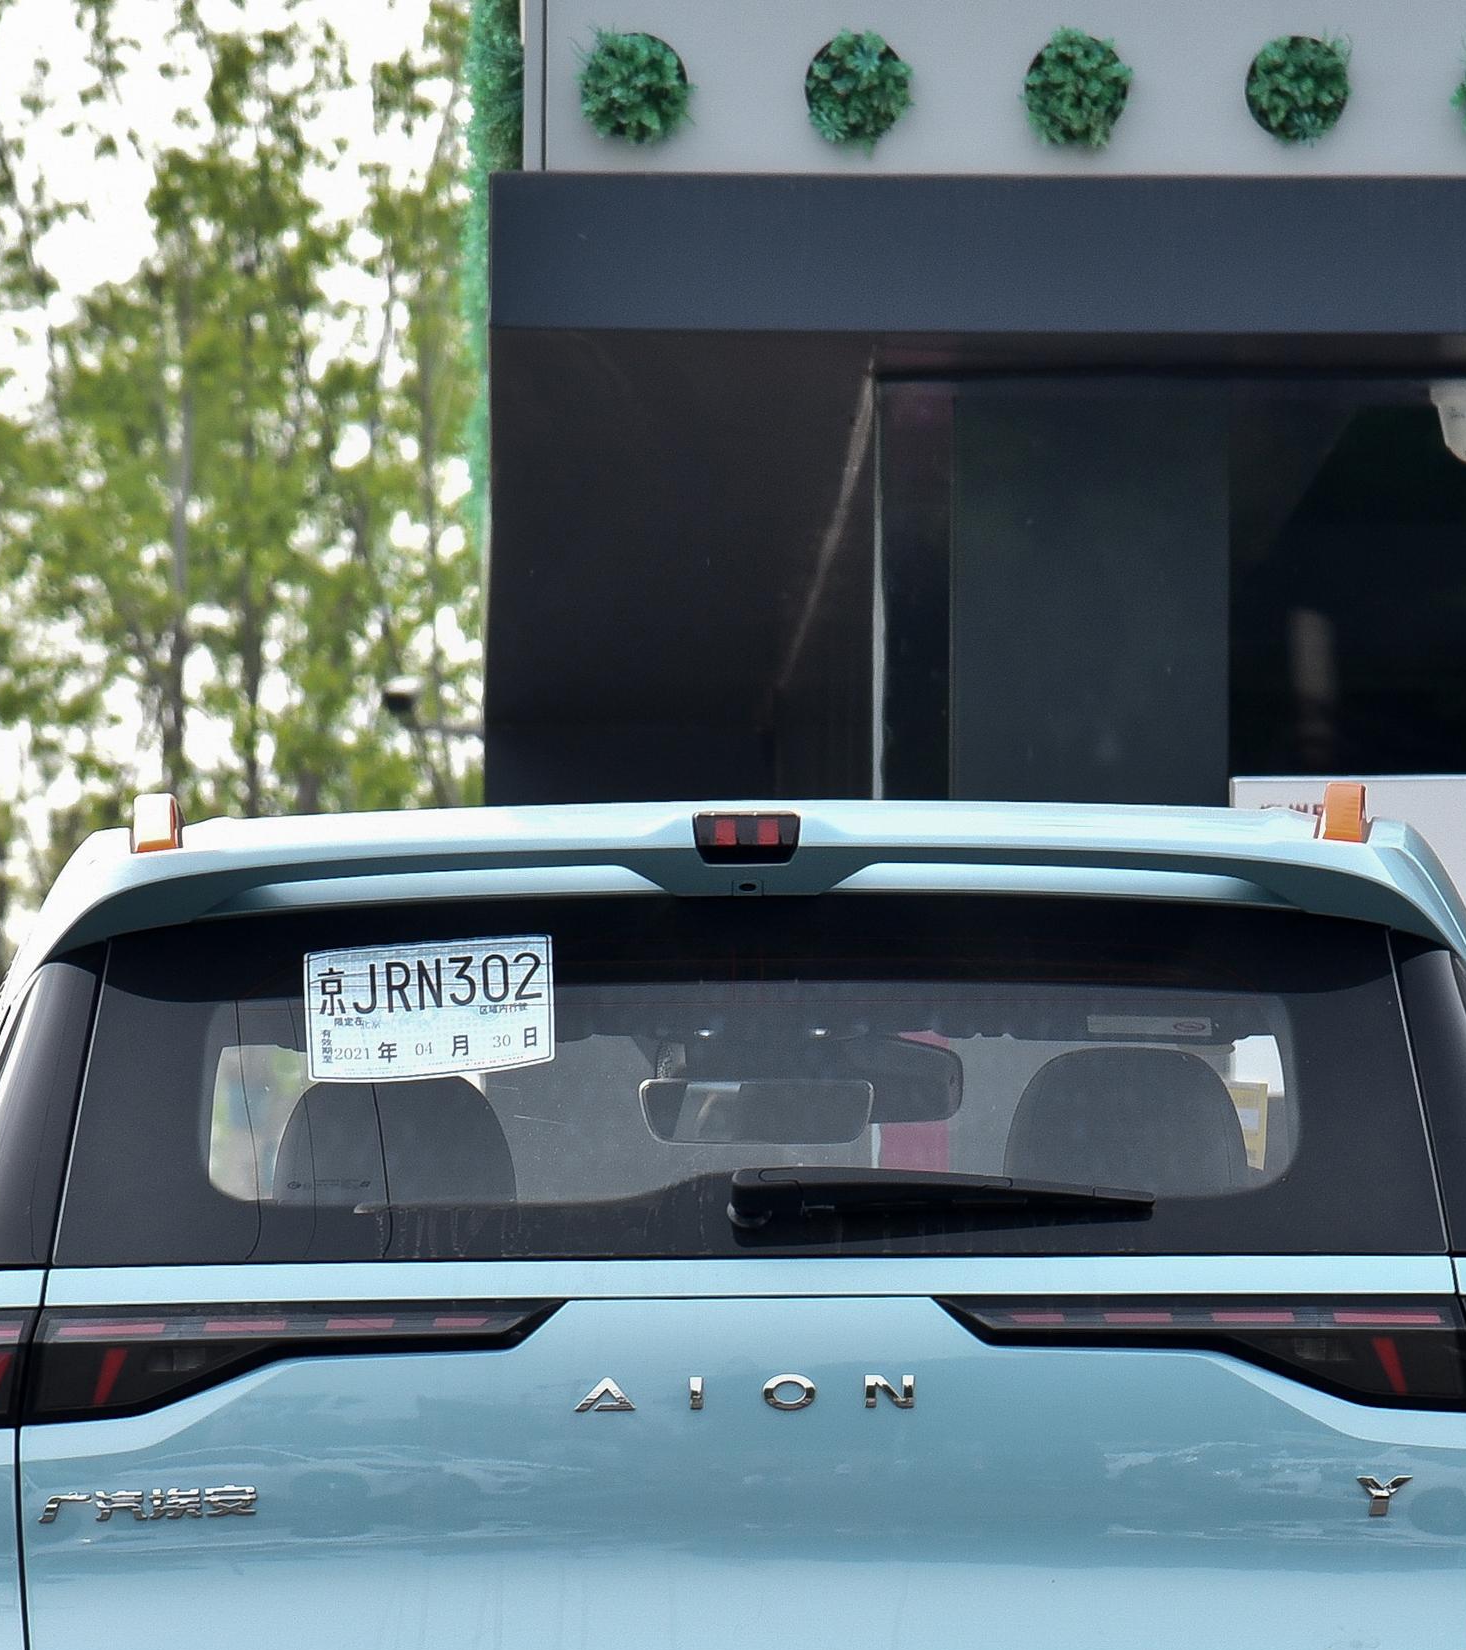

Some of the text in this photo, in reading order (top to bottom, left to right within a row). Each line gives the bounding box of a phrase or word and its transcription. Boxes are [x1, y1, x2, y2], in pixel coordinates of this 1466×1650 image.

[317, 952, 543, 1016] 京JRN302
[334, 1047, 370, 1060] 2021
[377, 1041, 397, 1063] 年
[452, 1034, 469, 1057] 月
[493, 1034, 511, 1048] 30
[524, 1026, 538, 1048] 日
[574, 1373, 915, 1412] AION
[38, 1485, 258, 1524] 广汽埃安
[1356, 1475, 1413, 1517] Y
